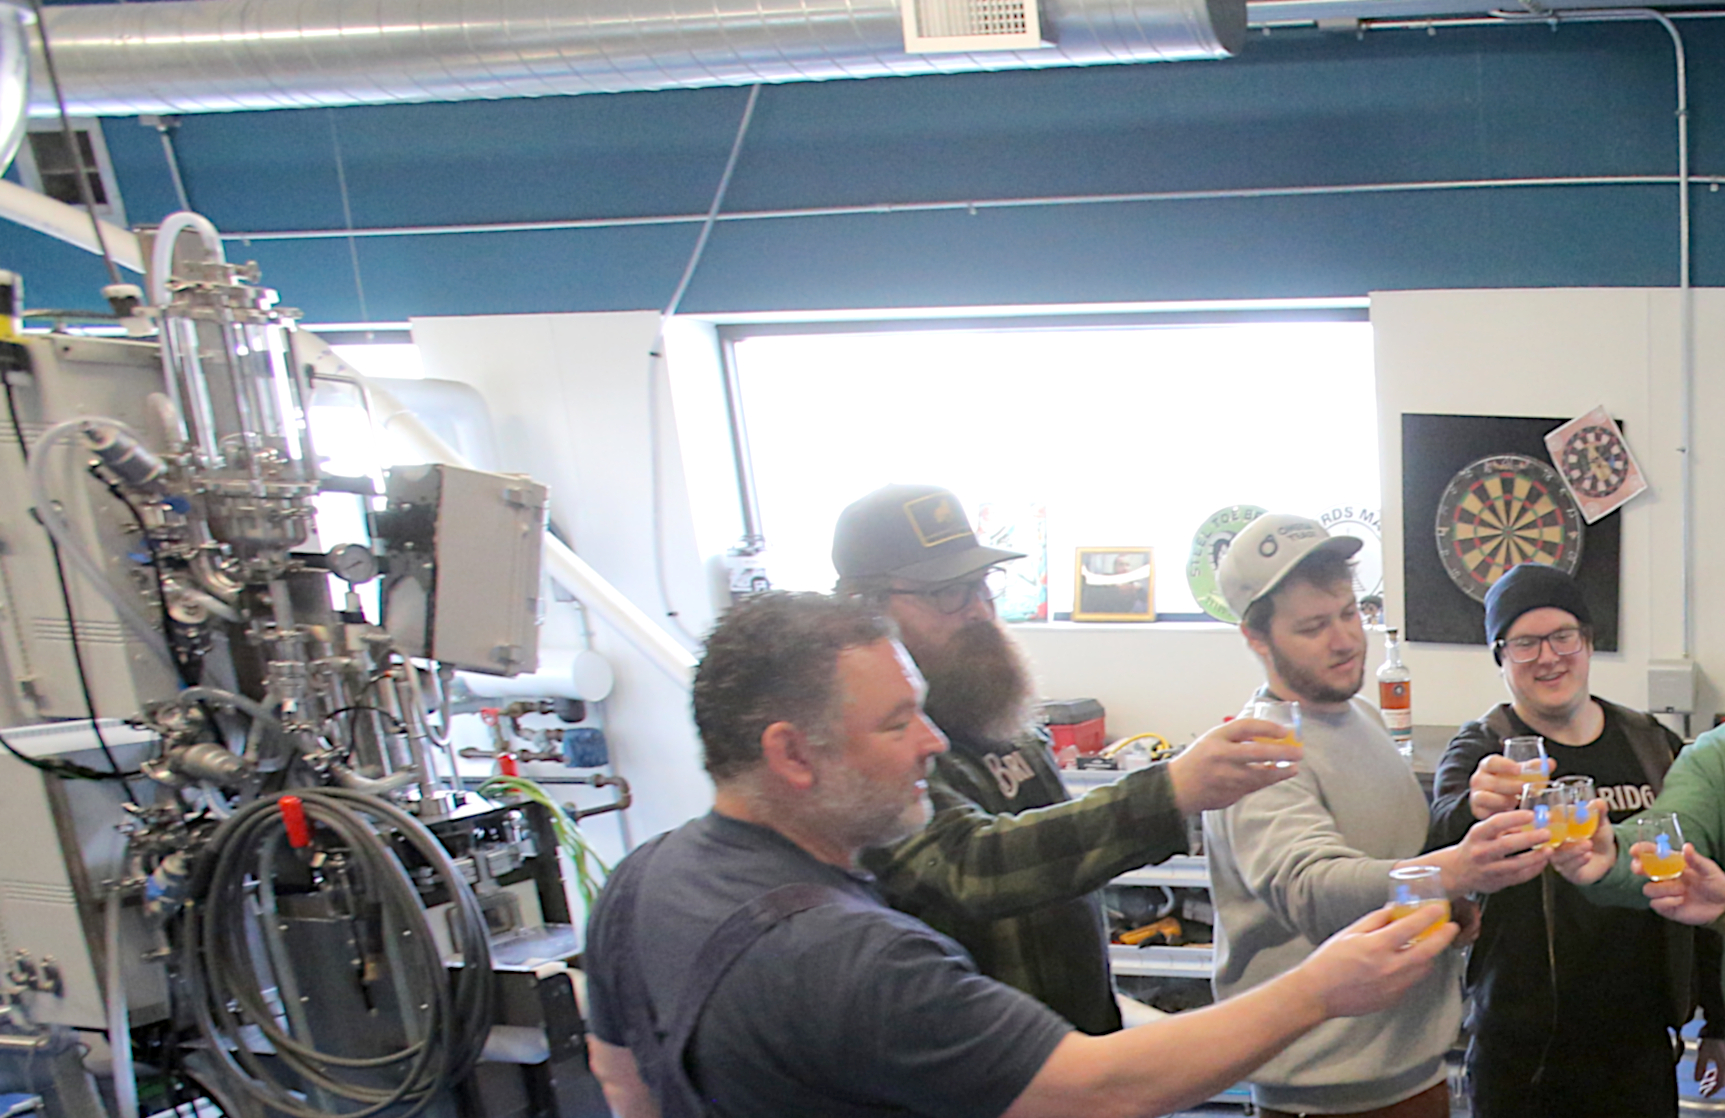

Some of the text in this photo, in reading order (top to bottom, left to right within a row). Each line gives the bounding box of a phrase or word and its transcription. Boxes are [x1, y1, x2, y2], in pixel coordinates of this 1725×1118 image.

[1190, 529, 1213, 578] STEEL
[1212, 510, 1240, 527] TOE
[1598, 784, 1656, 812] RIDG
